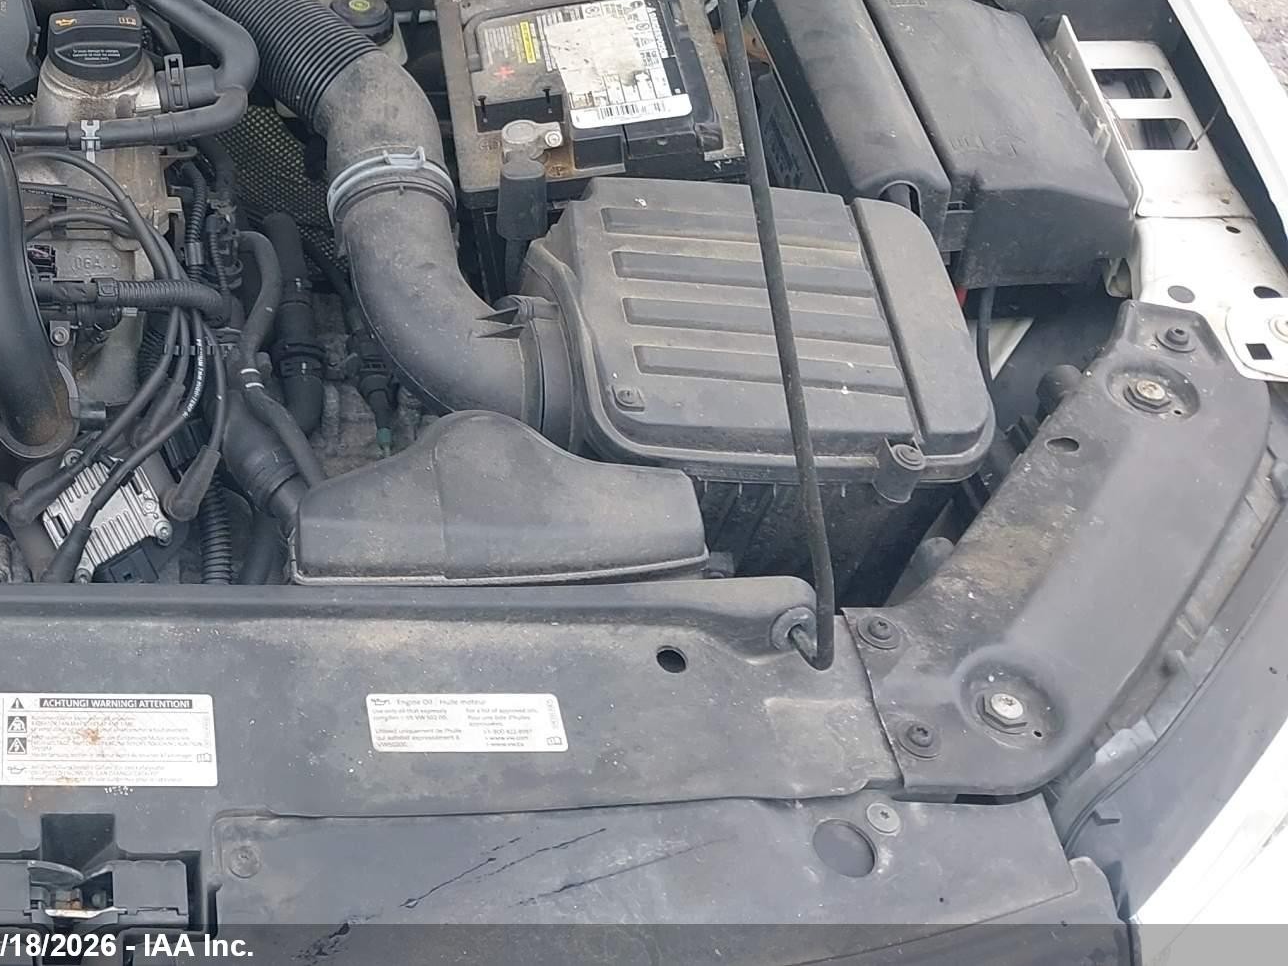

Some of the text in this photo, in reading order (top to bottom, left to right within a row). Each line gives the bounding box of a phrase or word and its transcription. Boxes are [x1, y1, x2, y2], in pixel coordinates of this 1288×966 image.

[42, 698, 190, 709] ACHTUNG! WARNING! ATTENTION!
[396, 698, 420, 706] Engine
